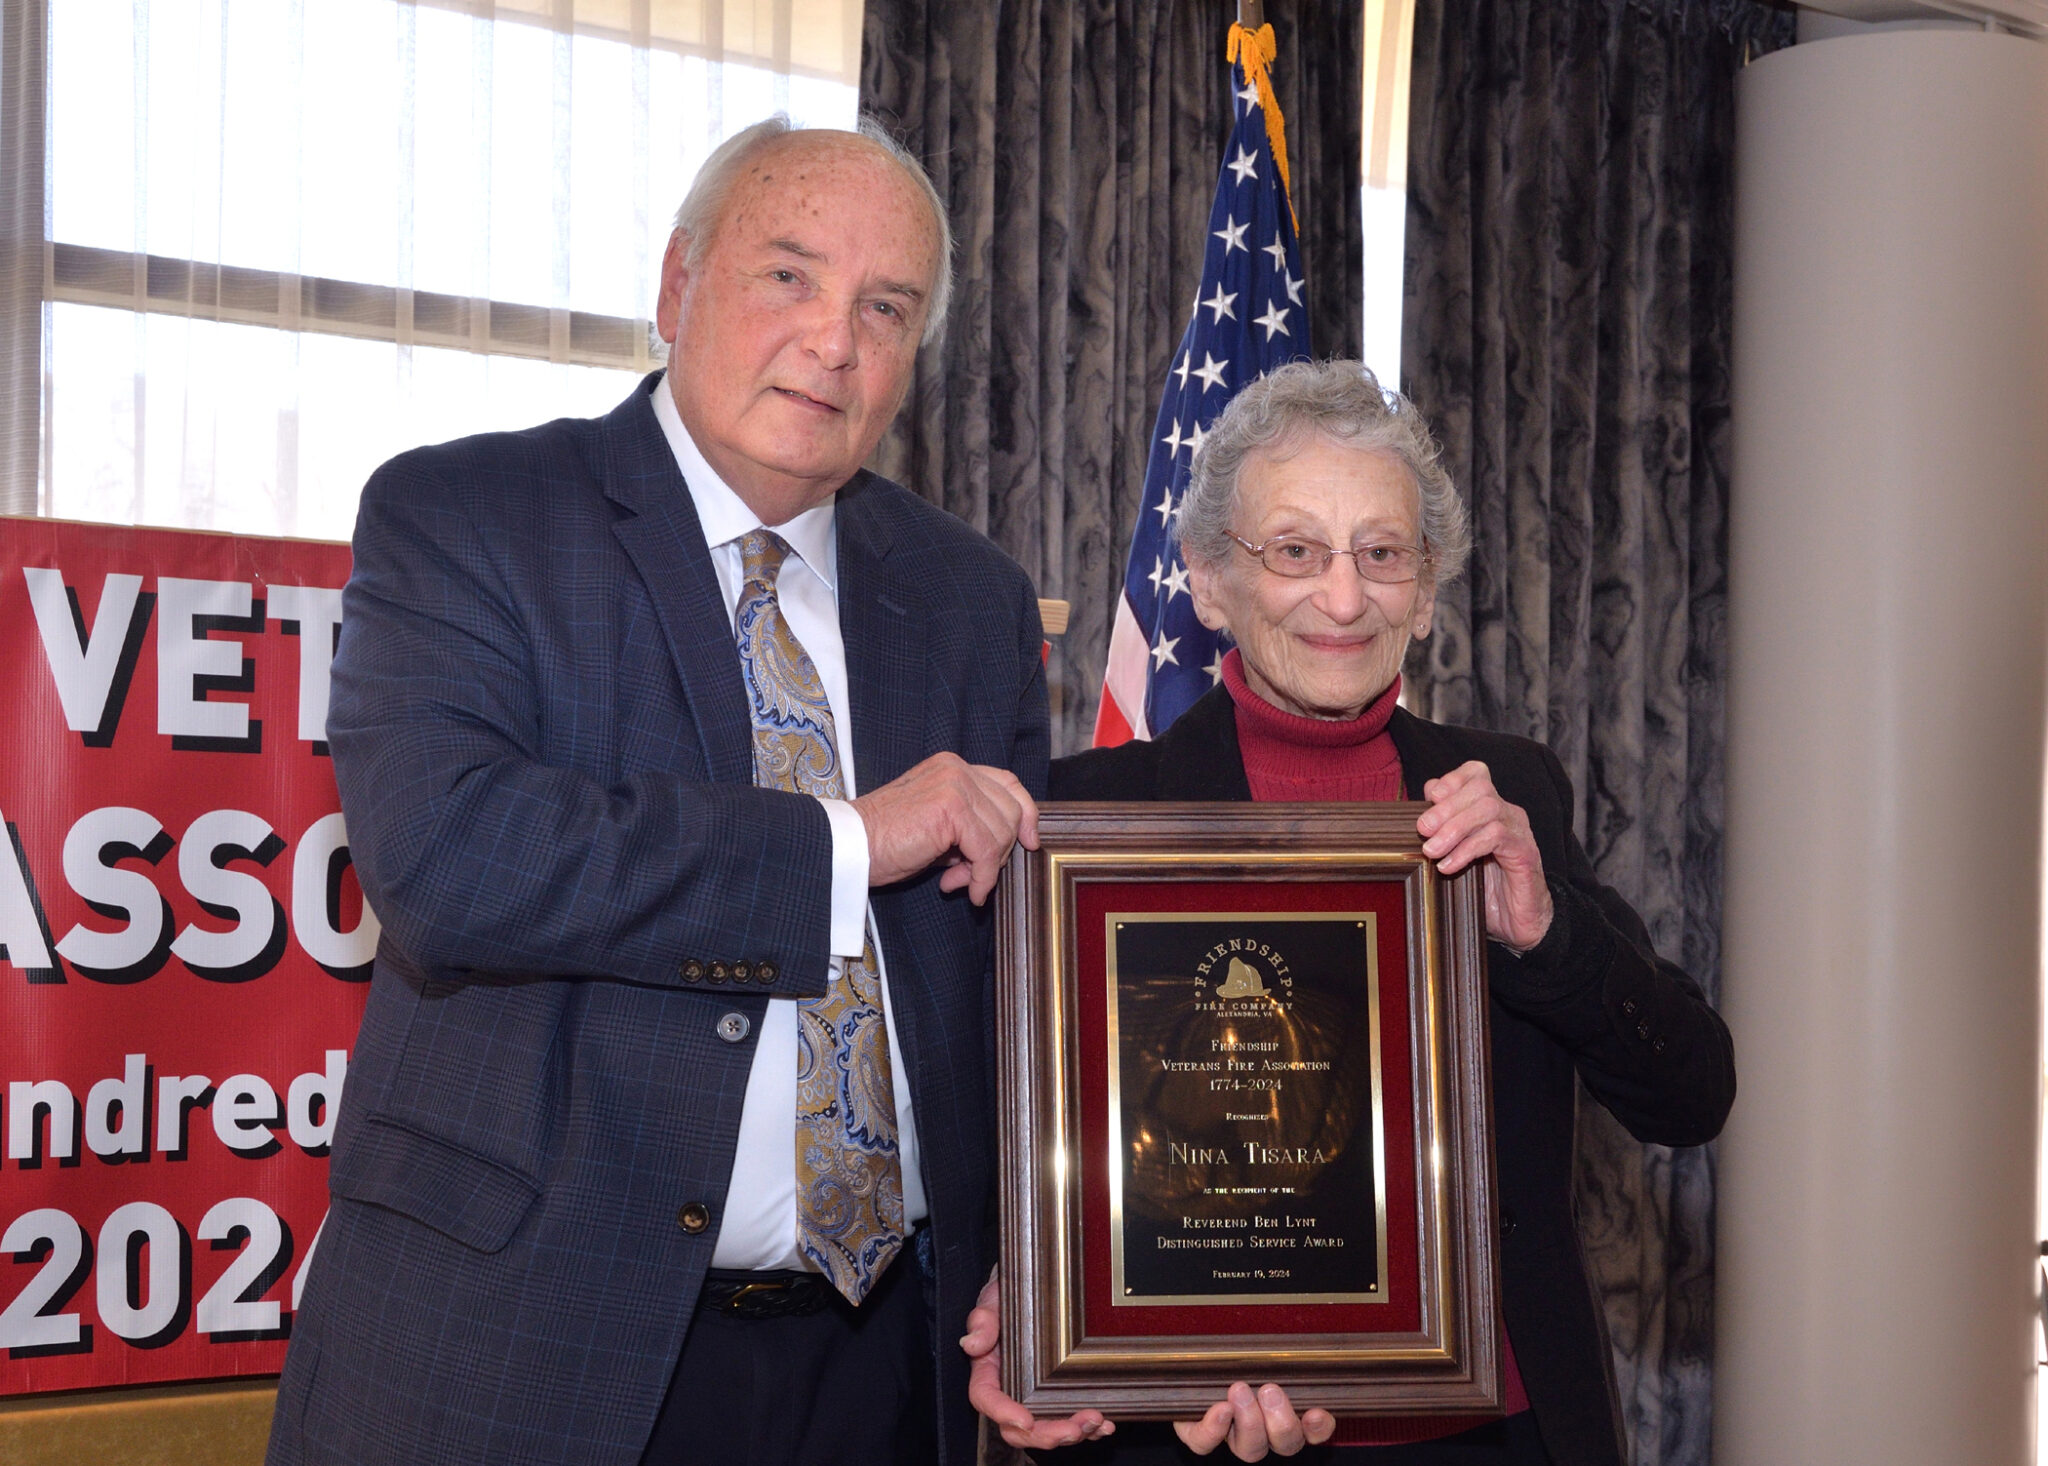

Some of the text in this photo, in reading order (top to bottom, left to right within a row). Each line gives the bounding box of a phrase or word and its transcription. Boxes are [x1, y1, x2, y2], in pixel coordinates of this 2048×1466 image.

[22, 567, 344, 743] VET
[1194, 938, 1293, 988] FRIENDSHIP
[1195, 1002, 1293, 1011] FIRE COMPANY
[1211, 1039, 1279, 1052] FRIENDSHIP
[1161, 1059, 1331, 1072] VETERANS FIRE ASSOCIATION
[1169, 1141, 1327, 1165] NINA TISARA
[1183, 1215, 1317, 1229] REVEREND BEN LYNT
[1157, 1235, 1344, 1249] DISTINGUISHED SERVICE AWARD
[0, 1197, 330, 1348] 202
[1212, 1269, 1290, 1279] FEBRUARY 19, 2024
